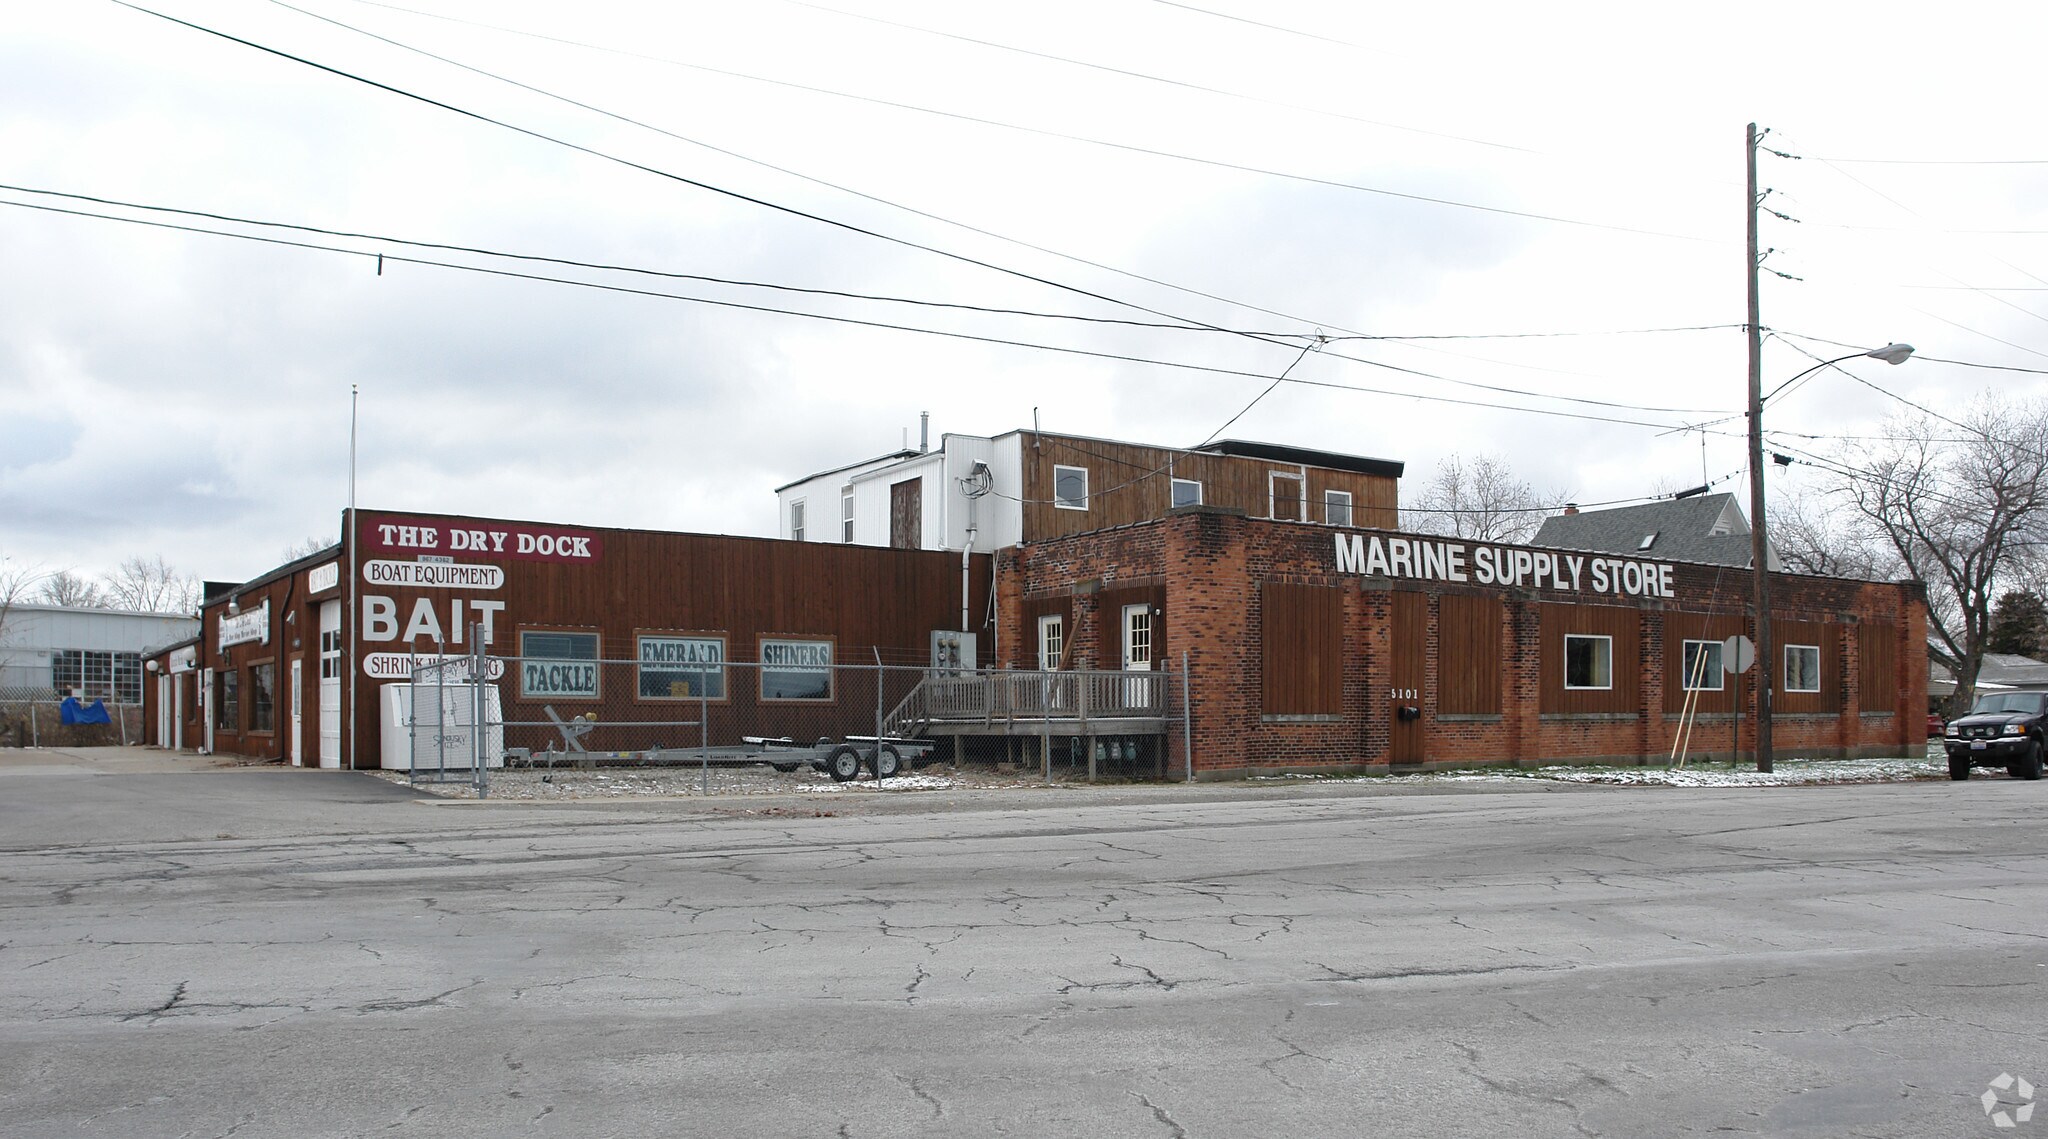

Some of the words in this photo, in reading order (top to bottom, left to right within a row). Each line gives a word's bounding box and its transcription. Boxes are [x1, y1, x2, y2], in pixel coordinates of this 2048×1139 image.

[378, 524, 438, 548] THE
[450, 529, 508, 552] DRY
[517, 533, 591, 557] DOCK
[371, 563, 411, 581] BOAT
[415, 566, 498, 586] EQUIPMENT
[1334, 533, 1468, 582] MARINE
[1475, 547, 1584, 591] SUPPLY
[1591, 558, 1675, 598] STORE
[363, 595, 505, 644] BAIT
[764, 644, 828, 669] SHINERS
[526, 665, 595, 692] TACKLE
[1391, 688, 1418, 700] 5101
